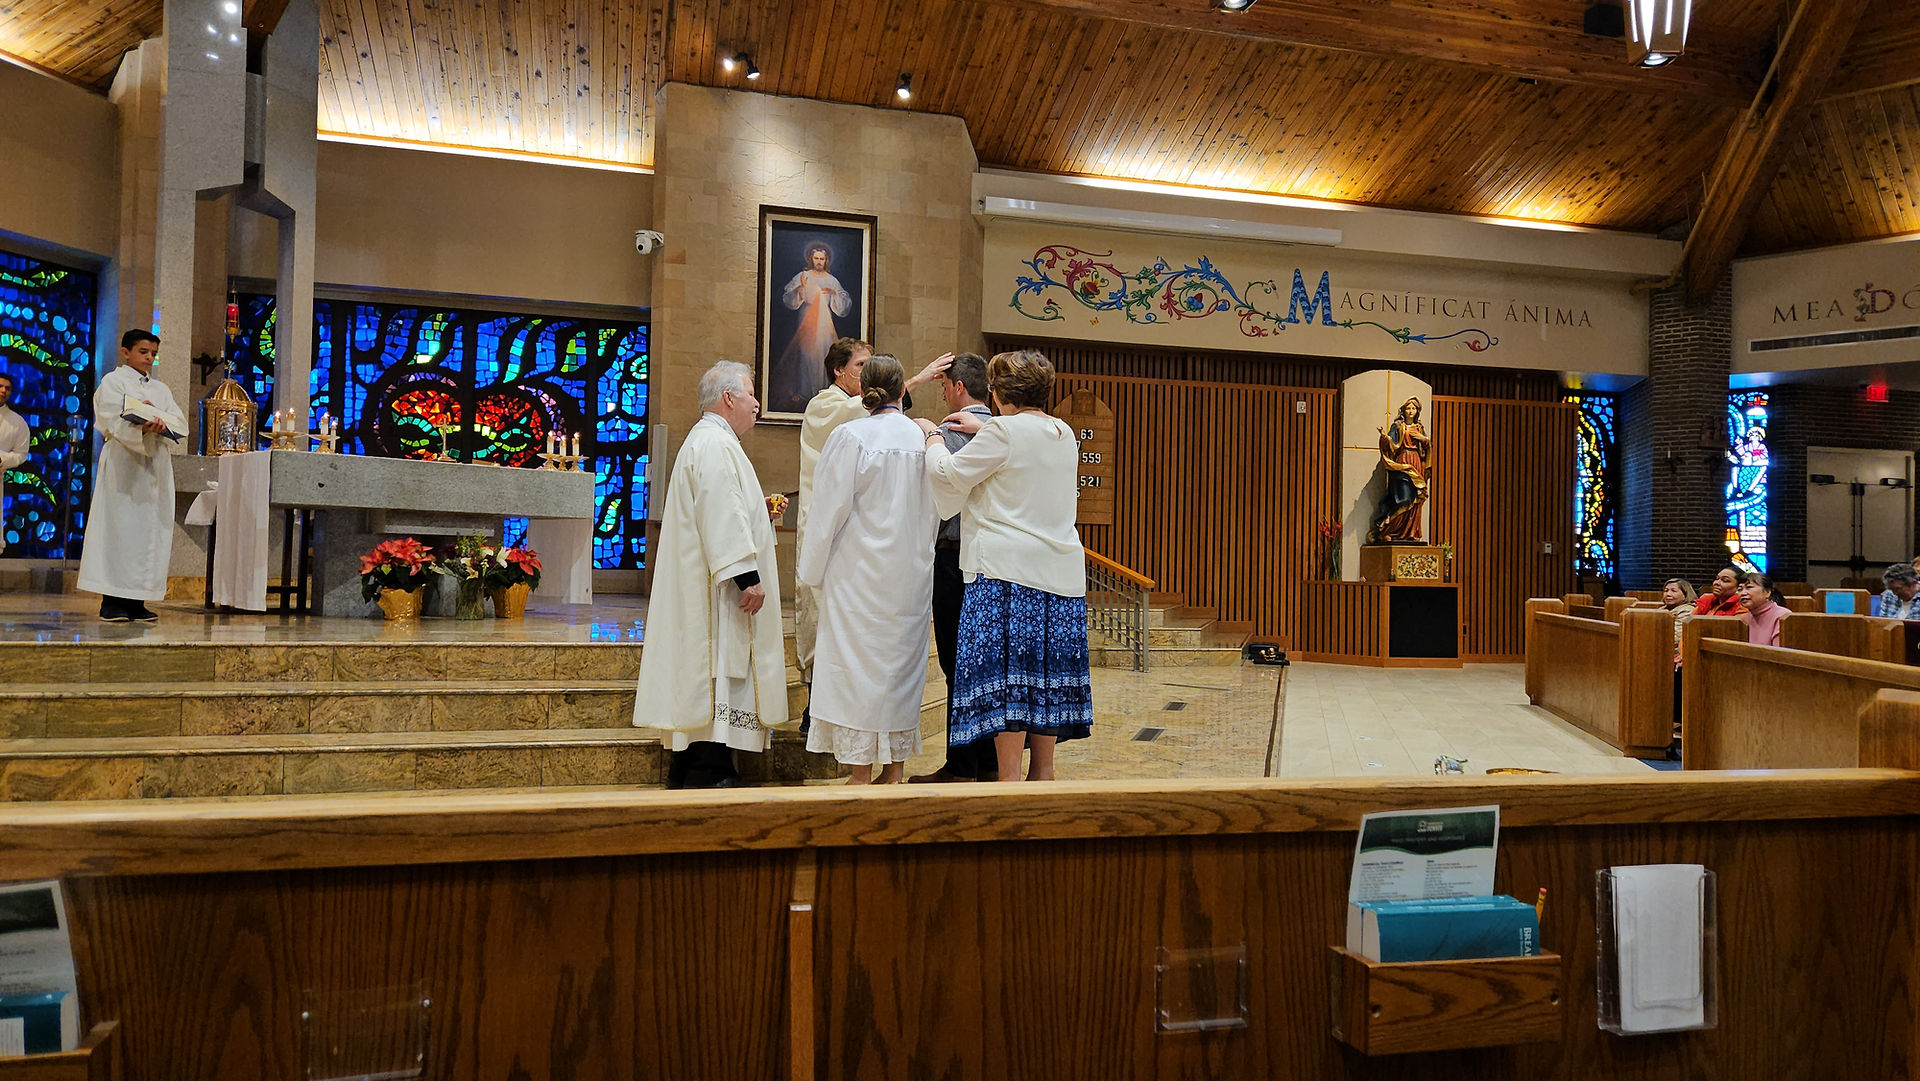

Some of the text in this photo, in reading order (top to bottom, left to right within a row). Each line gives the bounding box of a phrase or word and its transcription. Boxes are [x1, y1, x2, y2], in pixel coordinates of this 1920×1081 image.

[1504, 299, 1593, 327] ÁNIMA
[1773, 299, 1844, 324] MEA
[1080, 428, 1094, 440] 63
[1081, 452, 1102, 463] 559
[1080, 475, 1101, 488] 521
[1523, 927, 1532, 956] BREA
